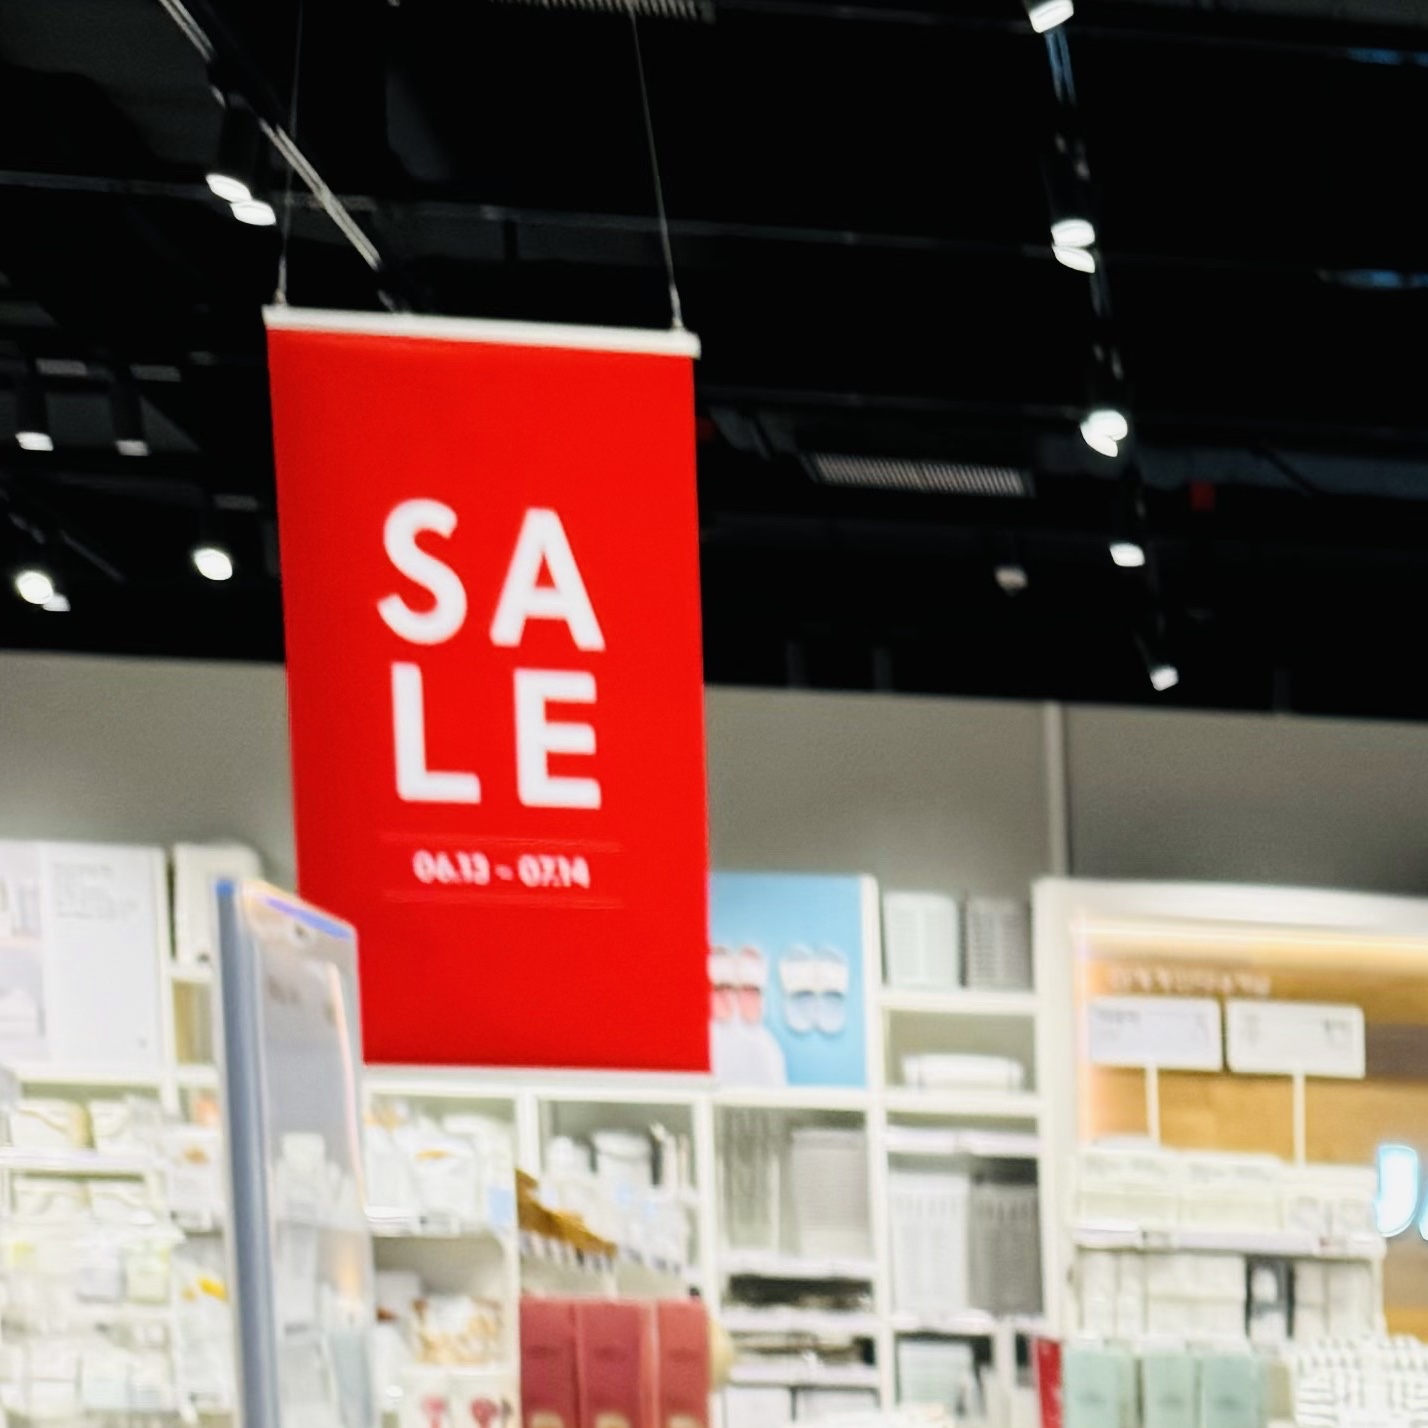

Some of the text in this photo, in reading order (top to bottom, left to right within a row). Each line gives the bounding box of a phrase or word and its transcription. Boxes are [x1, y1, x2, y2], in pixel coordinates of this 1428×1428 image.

[376, 496, 607, 652] SA
[390, 661, 603, 810] LE
[412, 849, 491, 884] 06.13
[517, 853, 592, 889] 07.14
